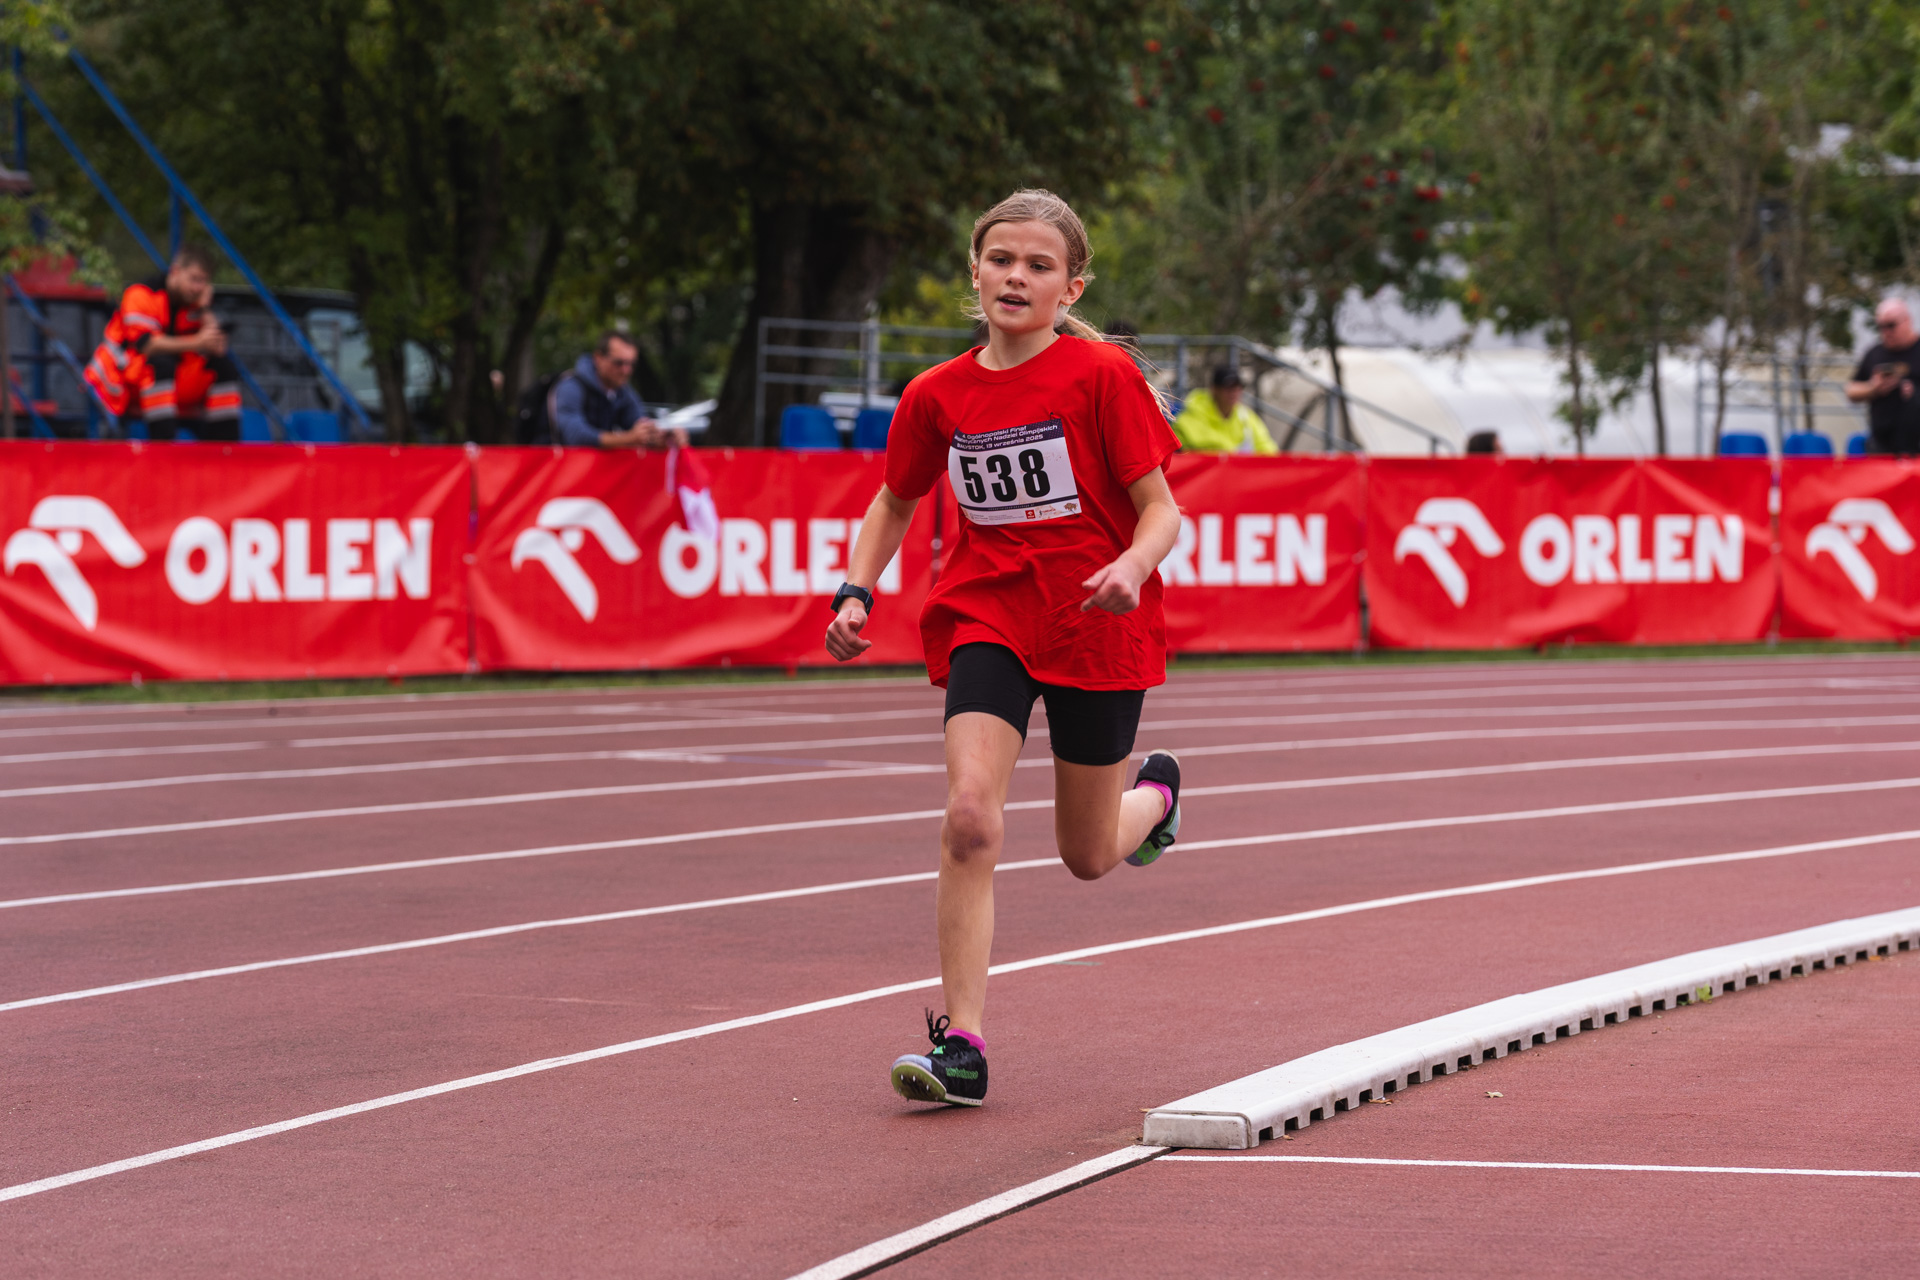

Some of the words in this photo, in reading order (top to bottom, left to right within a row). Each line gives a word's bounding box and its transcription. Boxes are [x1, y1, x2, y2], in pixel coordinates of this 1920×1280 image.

[959, 449, 1050, 503] 538
[166, 516, 433, 605] ORLEN
[1158, 513, 1327, 586] RLEN
[1519, 513, 1744, 586] ORLEN
